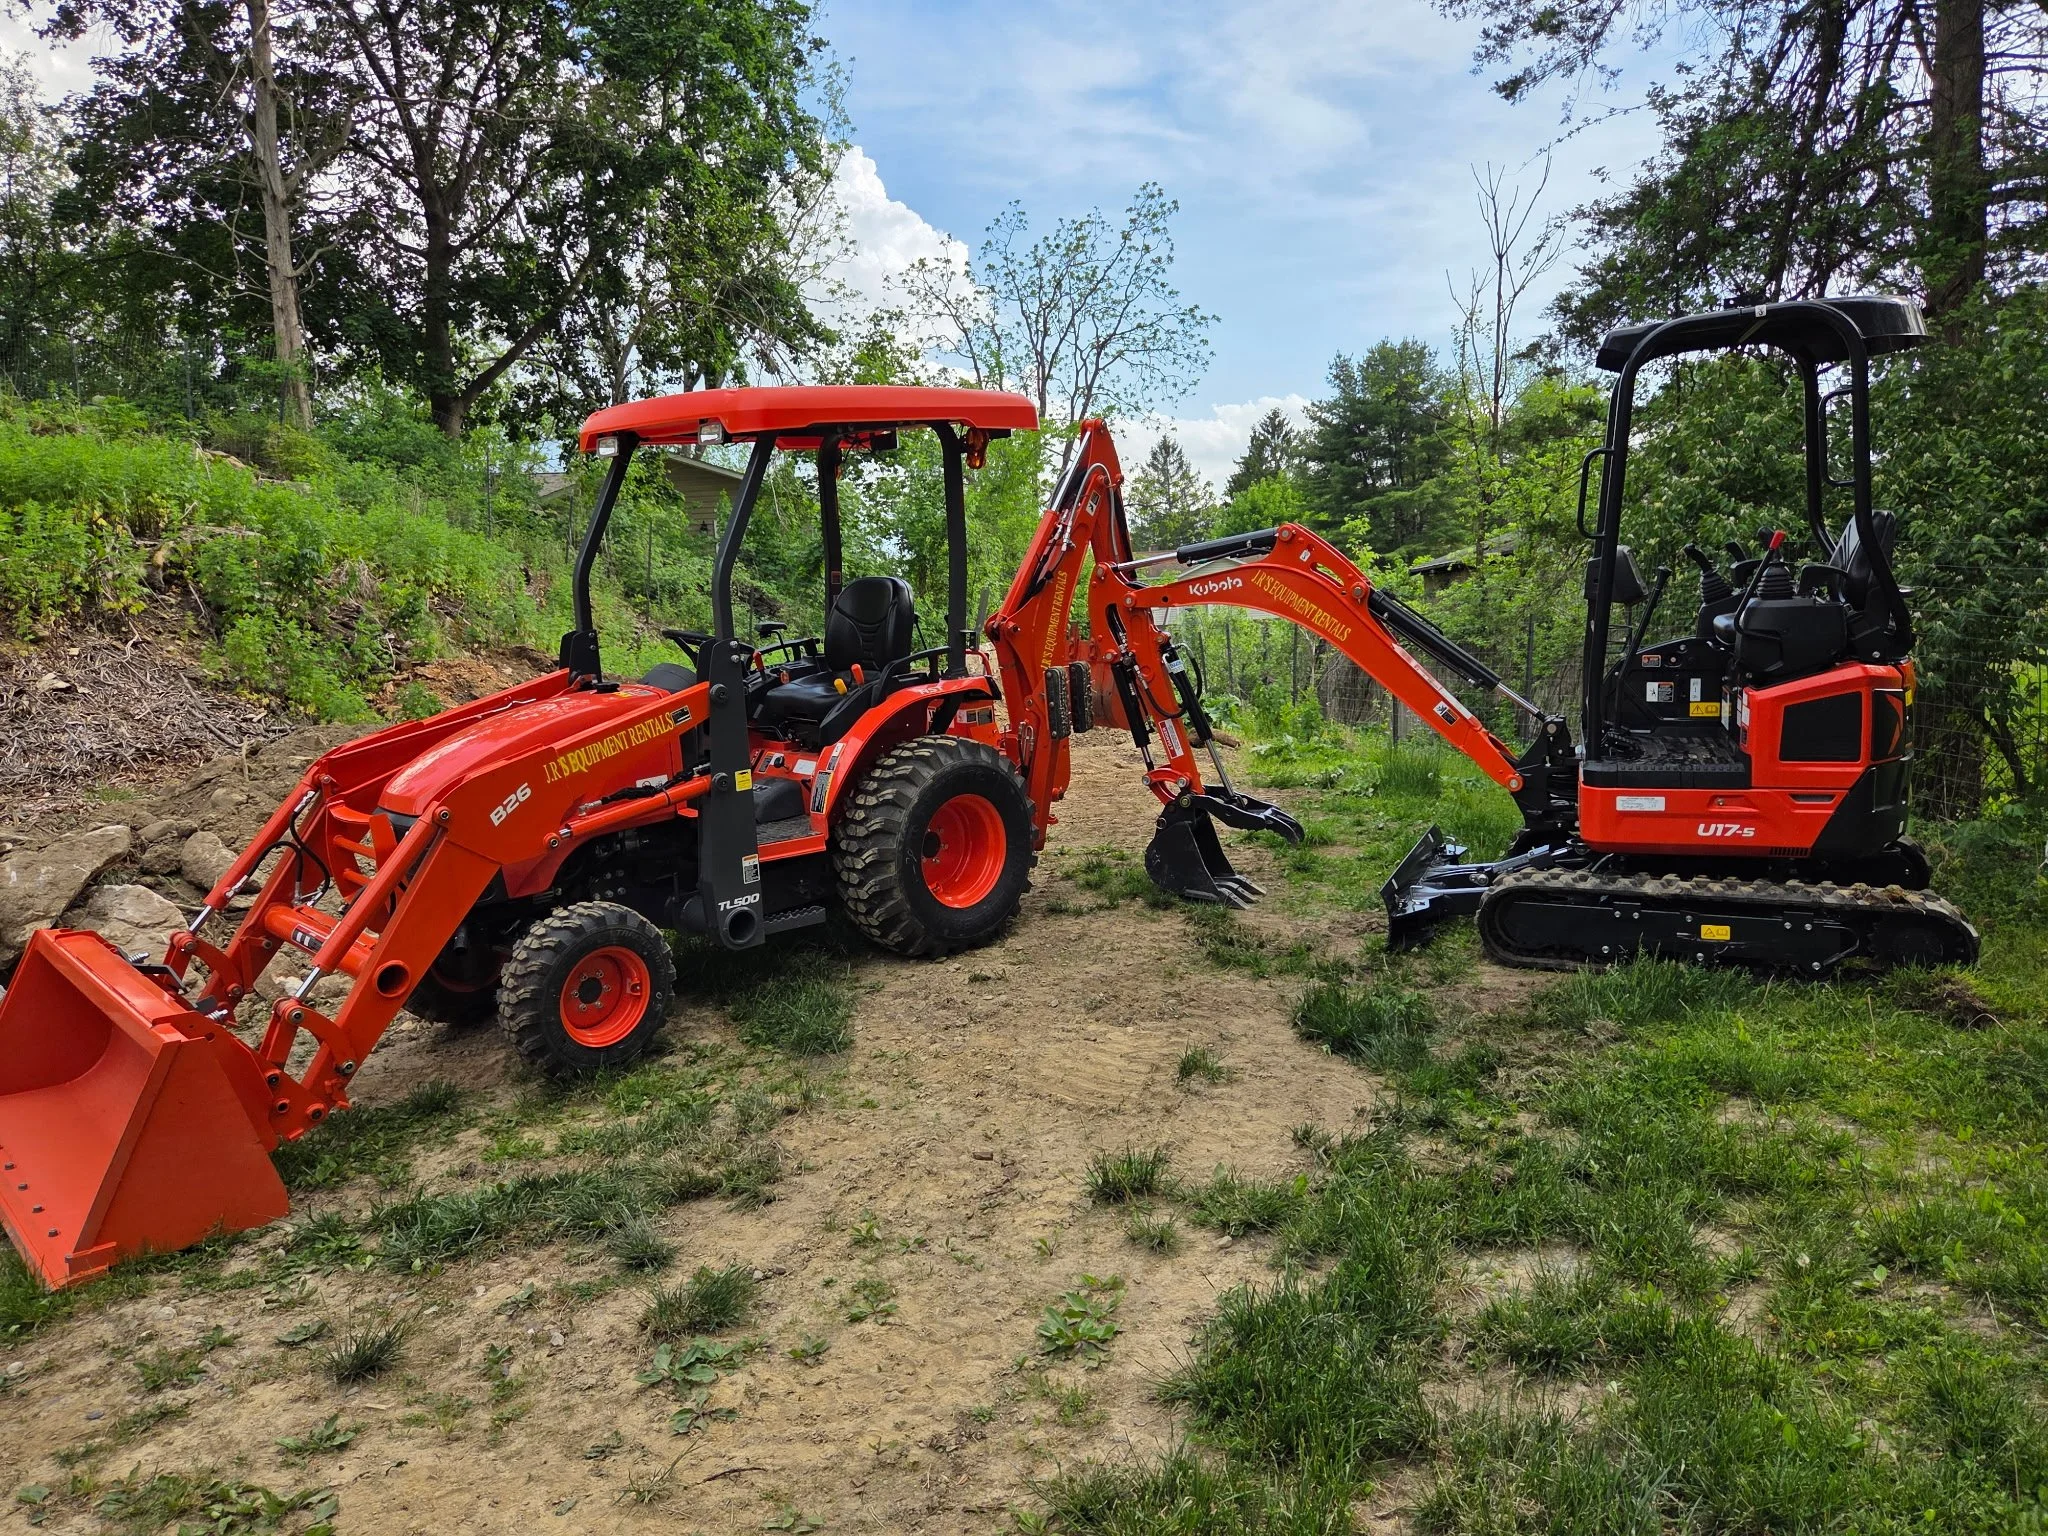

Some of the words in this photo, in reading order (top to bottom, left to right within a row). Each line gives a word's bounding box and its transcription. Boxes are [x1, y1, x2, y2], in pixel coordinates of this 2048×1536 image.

[1045, 606, 1060, 651] EQUIPMENT
[1053, 570, 1068, 607] RENTALS
[1189, 576, 1243, 596] Kubota
[1269, 580, 1316, 619] EQUIPMENT
[1312, 608, 1352, 642] RENTALS
[567, 731, 629, 773] EQUIPMENT
[628, 712, 674, 746] RENTALS
[490, 782, 532, 827] B26
[718, 892, 760, 911] TL500
